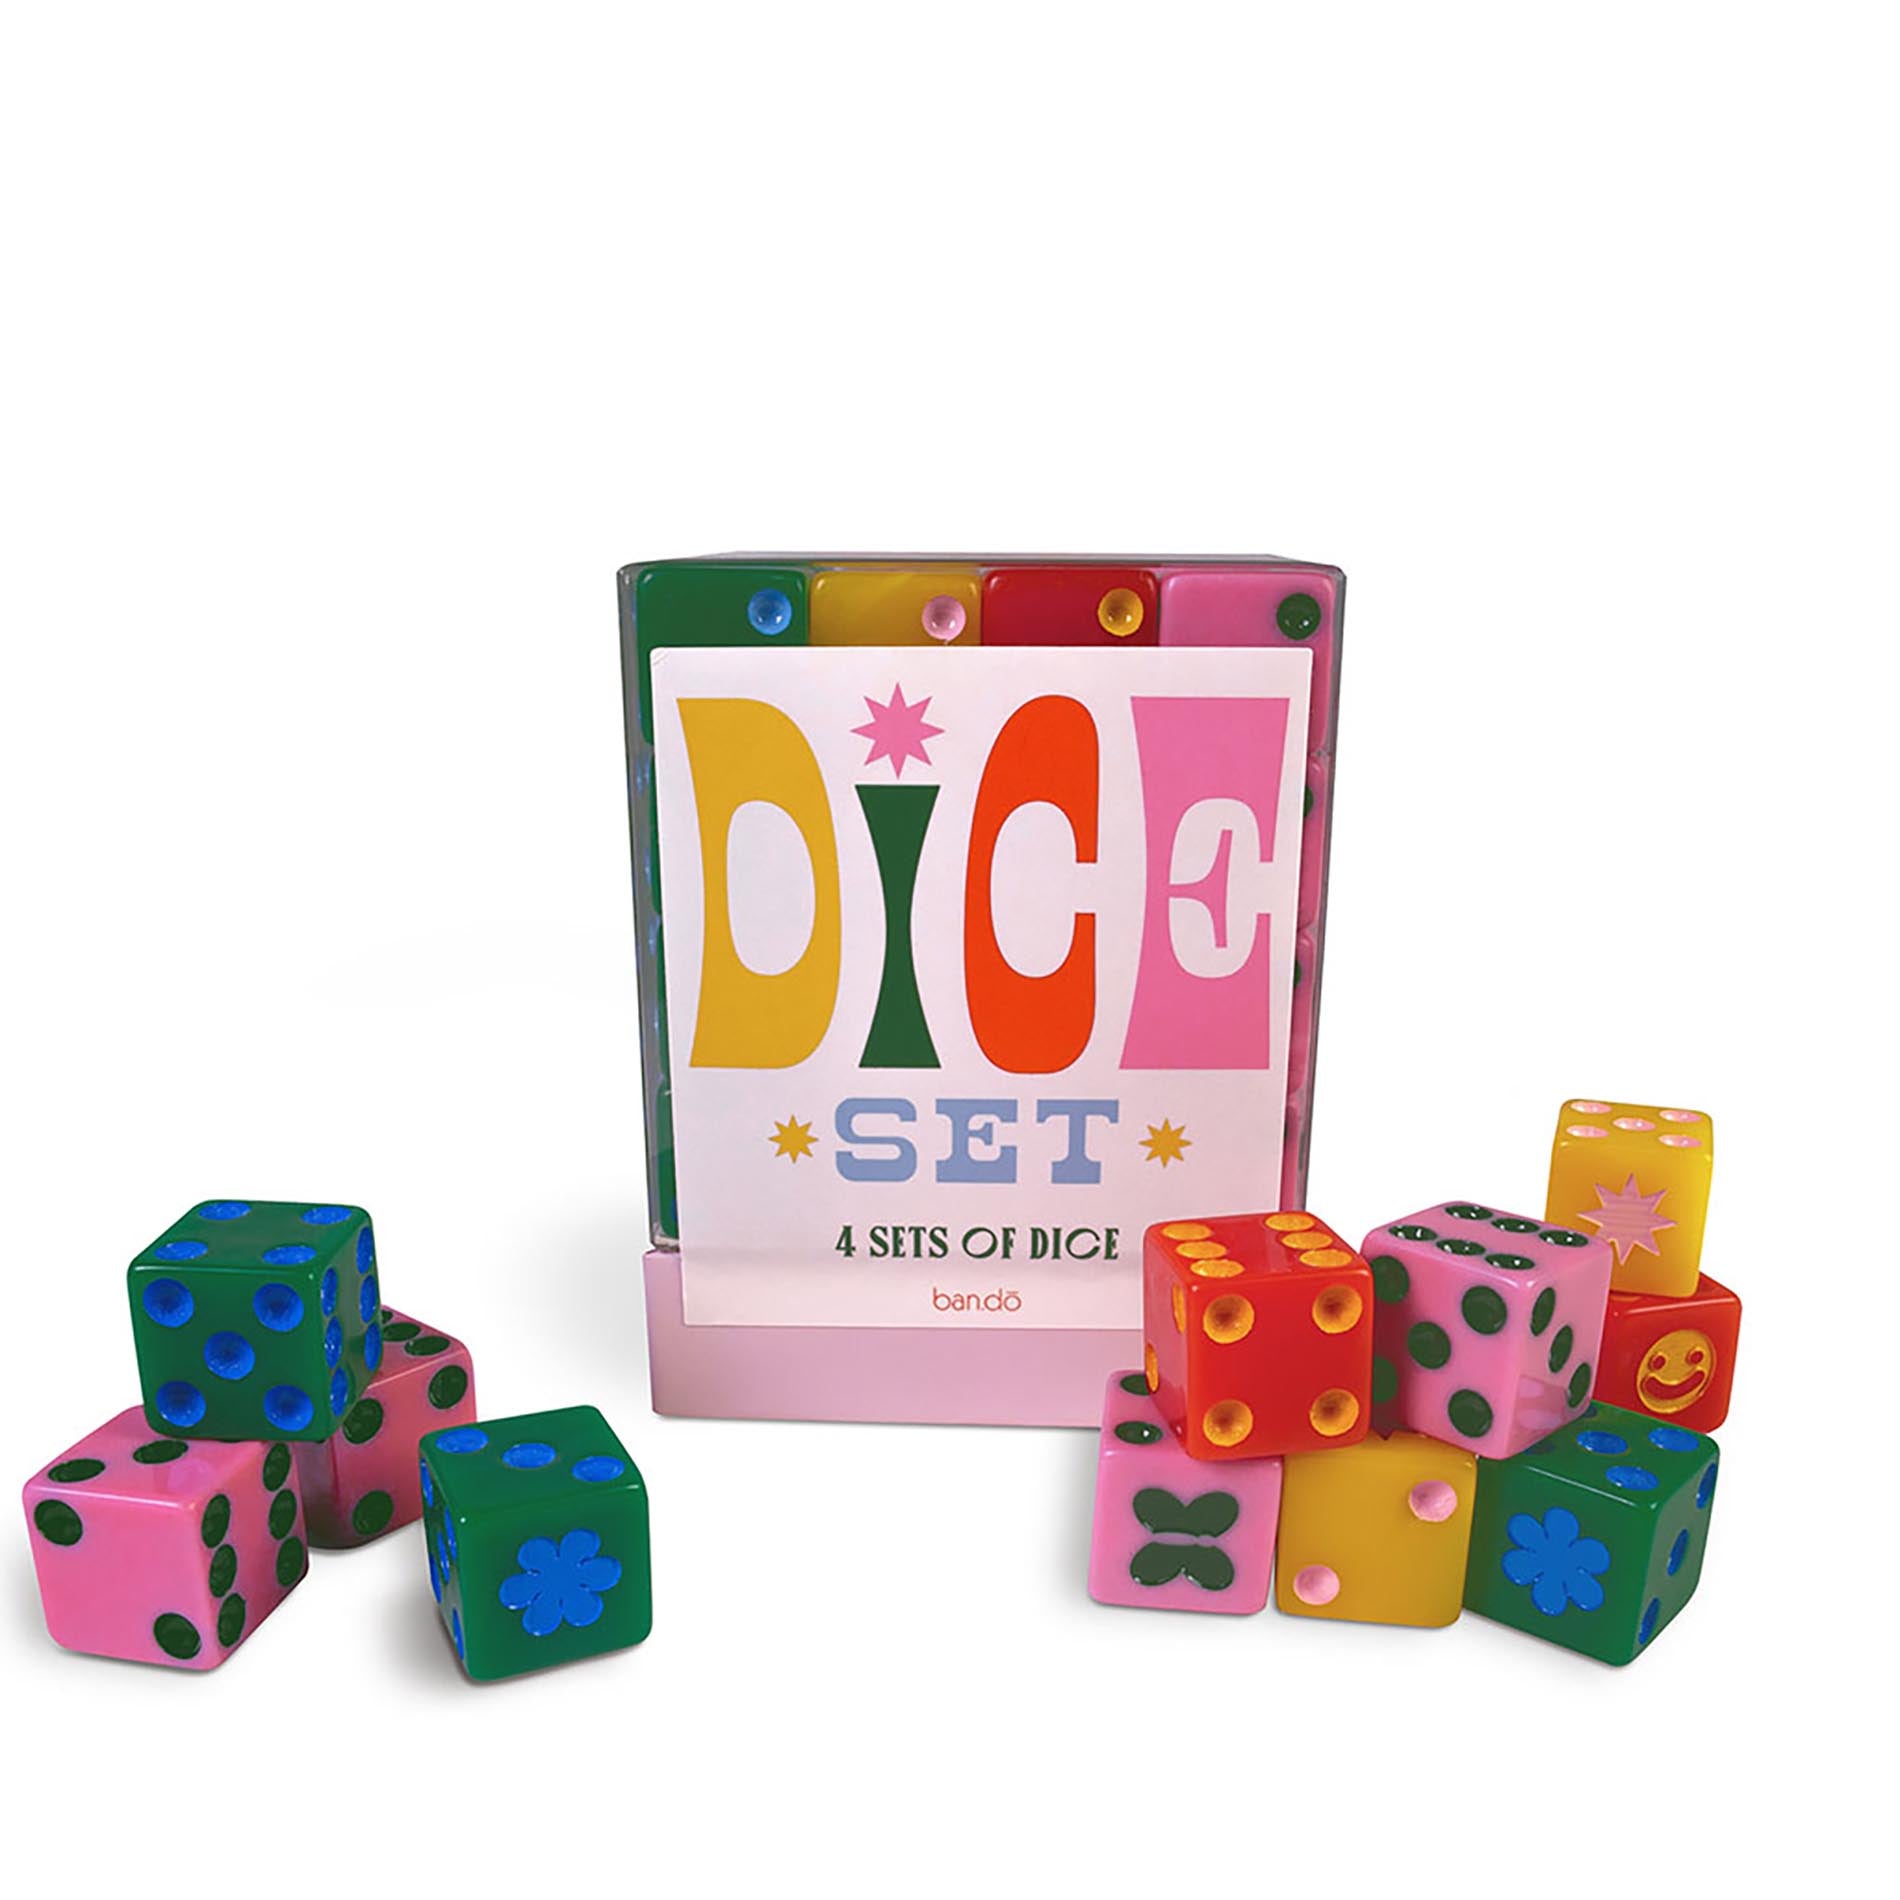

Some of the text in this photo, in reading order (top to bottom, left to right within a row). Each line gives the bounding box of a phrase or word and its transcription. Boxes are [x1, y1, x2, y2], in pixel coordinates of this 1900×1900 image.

[835, 1098, 1119, 1184] SET
[835, 1225, 1120, 1261] 4 SETS OF DICE
